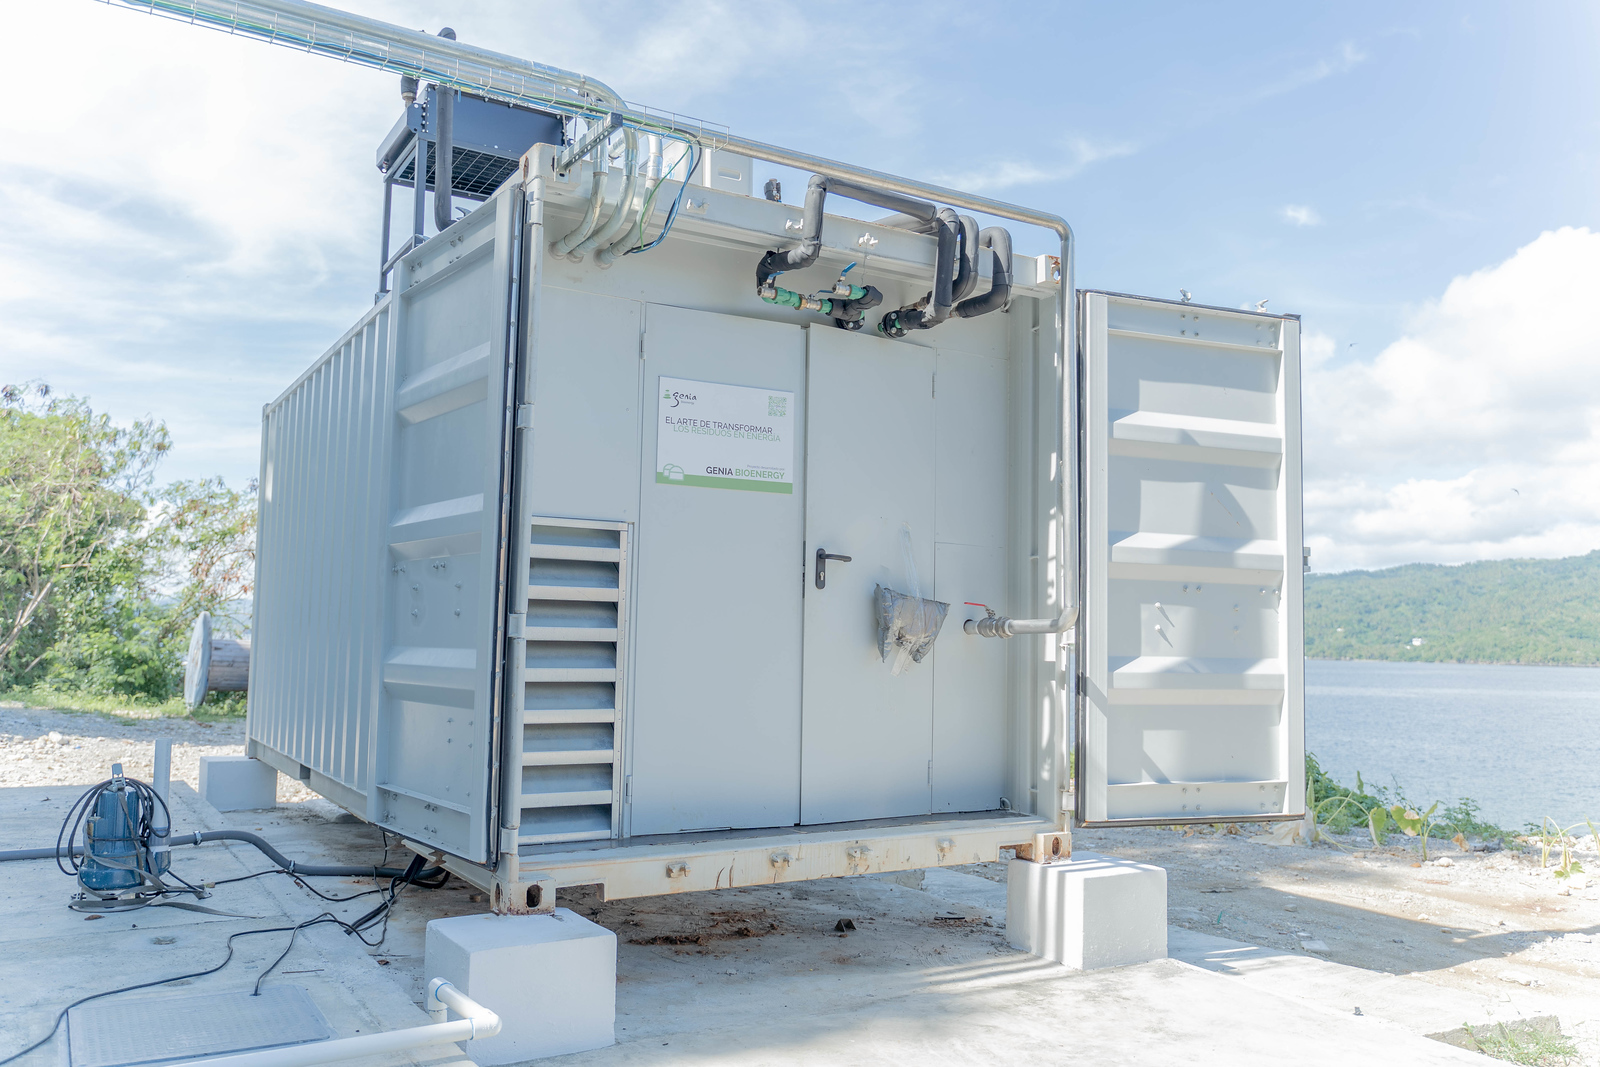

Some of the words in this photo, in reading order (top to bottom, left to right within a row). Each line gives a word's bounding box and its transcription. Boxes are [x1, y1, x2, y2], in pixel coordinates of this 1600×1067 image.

[665, 416, 675, 424] EL
[677, 417, 698, 427] ARTE
[700, 420, 711, 428] DE
[713, 421, 773, 434] TRANSFORMAR
[673, 425, 690, 433] LOS
[691, 426, 732, 437] RESIDUOS
[733, 431, 745, 439] EN
[705, 466, 734, 476] GENIA
[735, 468, 785, 480] BIOENERGY
